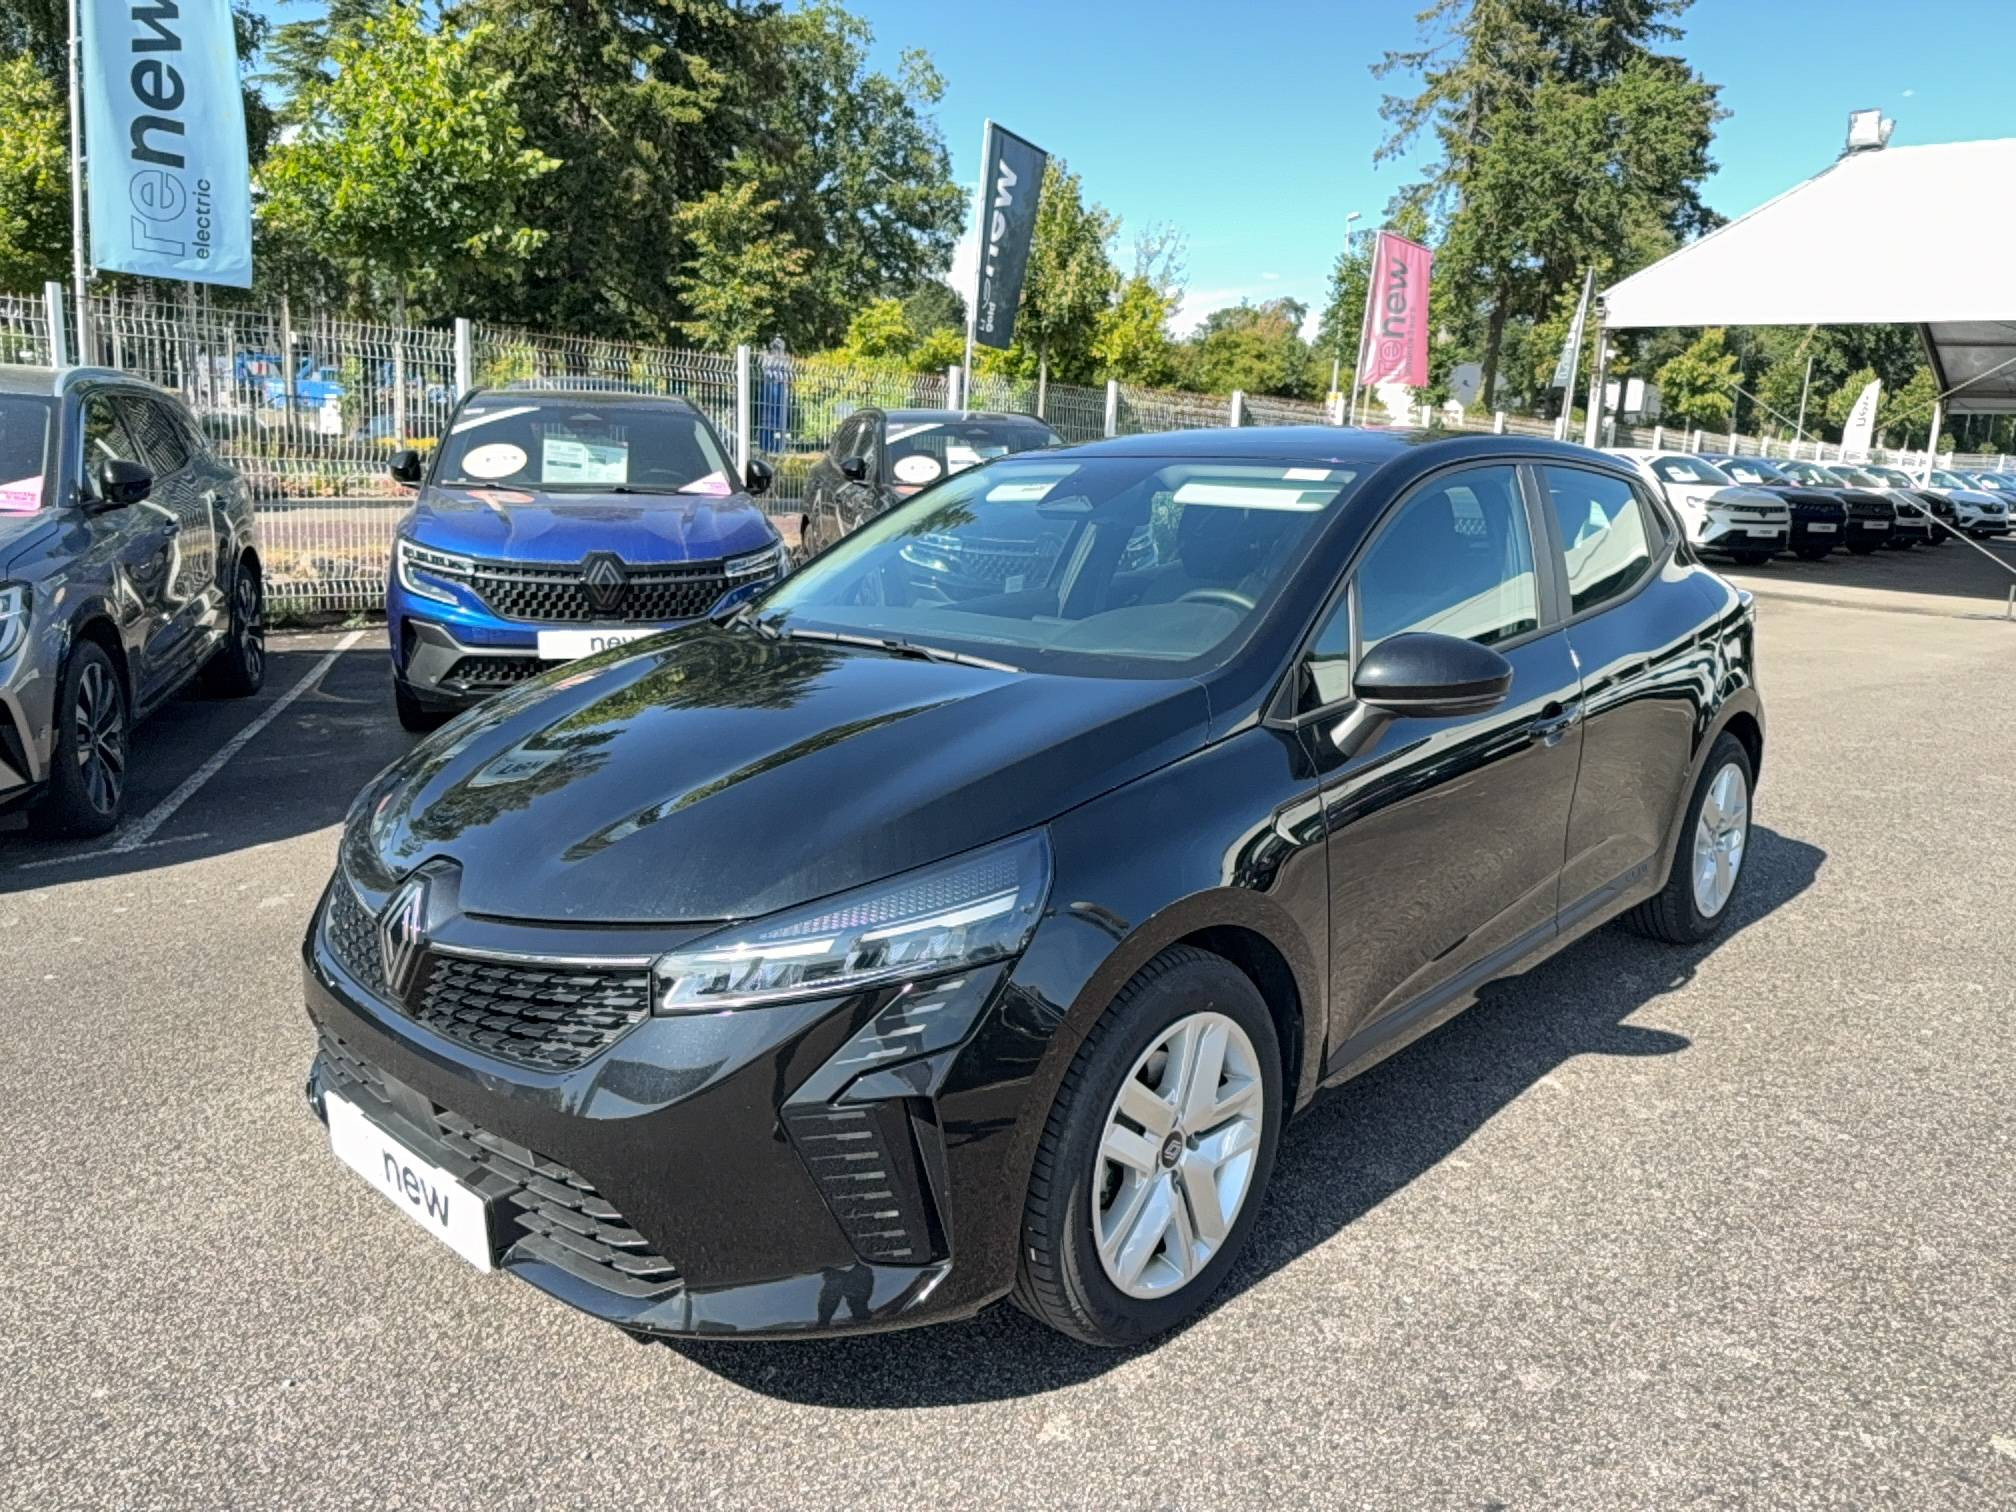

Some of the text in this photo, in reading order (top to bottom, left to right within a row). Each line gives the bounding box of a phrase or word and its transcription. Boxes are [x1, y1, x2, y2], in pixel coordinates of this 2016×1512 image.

[191, 178, 211, 260] electric
[1378, 259, 1408, 376] renew
[382, 1148, 449, 1228] new
